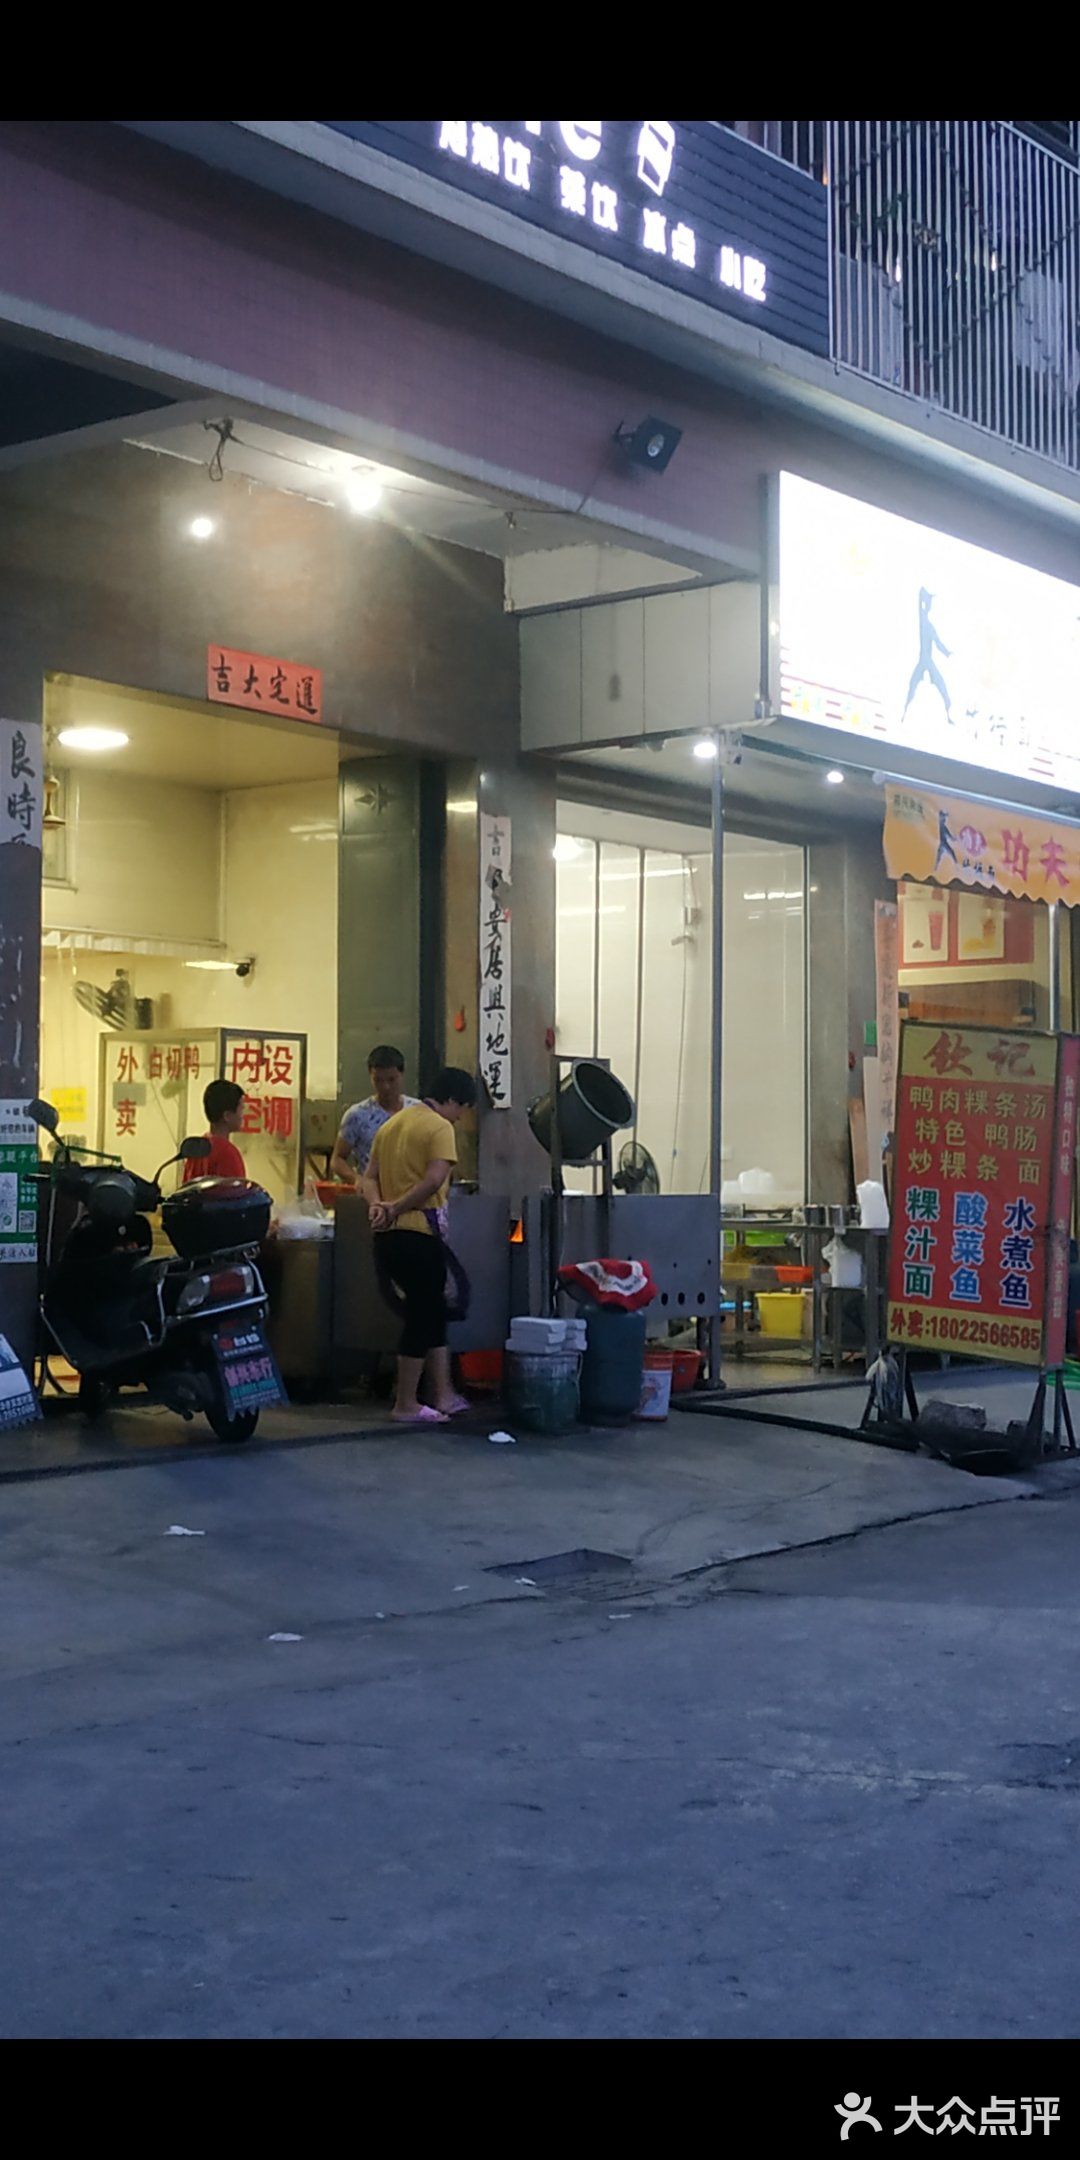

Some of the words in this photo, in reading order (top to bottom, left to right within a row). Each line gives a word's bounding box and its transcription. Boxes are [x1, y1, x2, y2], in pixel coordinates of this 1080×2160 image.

[232, 1042, 293, 1085] 内设
[909, 1085, 1047, 1120] 鸭肉粿条汤
[915, 1117, 966, 1147] 特色
[984, 1122, 1037, 1152] 鸭肠
[907, 1148, 999, 1181] 炒粿条
[1018, 1157, 1042, 1185] 面
[903, 1185, 940, 1298] 粿汁面
[950, 1191, 988, 1302] 酸菜鱼
[999, 1196, 1037, 1309] 水煮鱼
